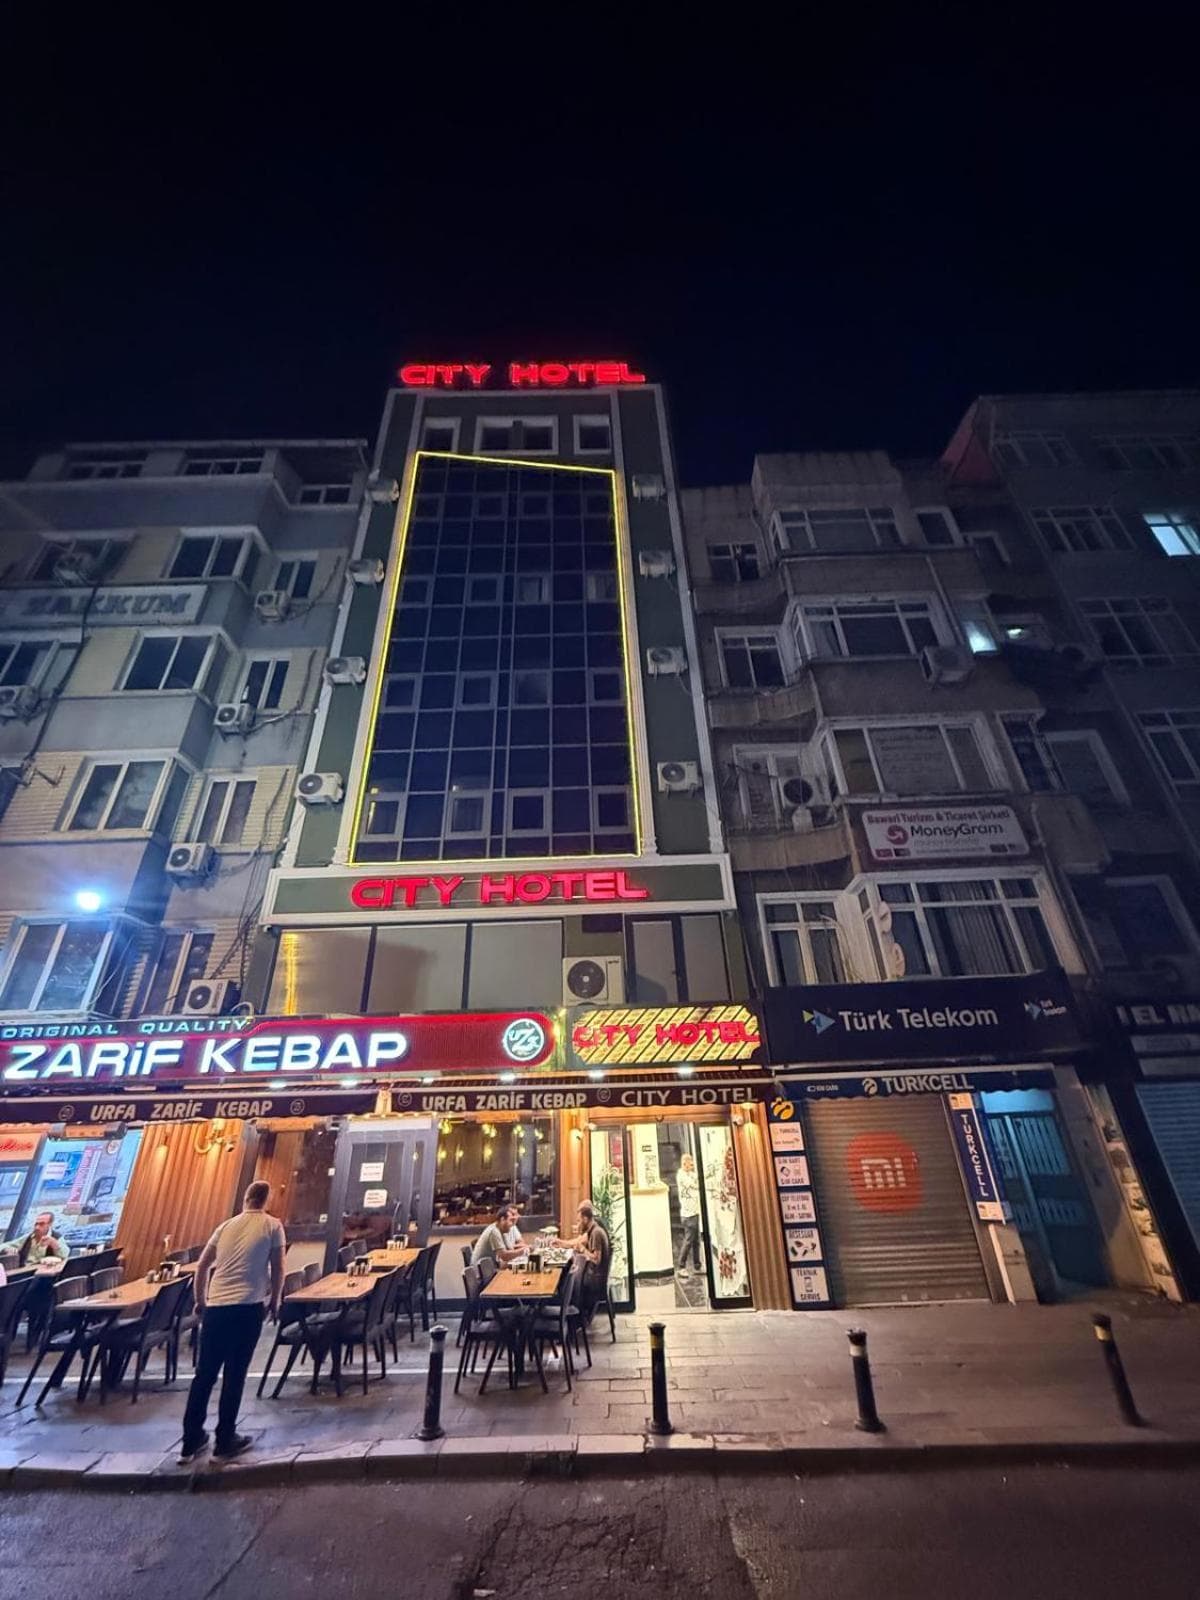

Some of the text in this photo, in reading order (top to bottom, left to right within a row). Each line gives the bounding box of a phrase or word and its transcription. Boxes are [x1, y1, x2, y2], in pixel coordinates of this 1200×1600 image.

[400, 362, 646, 385] CITY HOTEL
[911, 822, 1004, 839] MoneyGram
[351, 871, 648, 908] CITY HOTEL
[2, 1018, 247, 1039] ORIGINAL QUALITY
[839, 1007, 999, 1032] Türk Telekom
[656, 1021, 762, 1046] HOTEL
[199, 1032, 408, 1074] KEBAP
[882, 1074, 975, 1094] TURKCELL
[422, 1095, 466, 1111] URFA
[476, 1091, 525, 1109] ZARİF
[531, 1092, 588, 1108] KEBAP
[621, 1090, 671, 1107] CITY
[681, 1087, 758, 1104] HOTEL
[90, 1103, 136, 1121] URFA
[150, 1099, 203, 1118] ZARİF
[215, 1100, 273, 1117] KEBAP
[961, 1113, 989, 1198] TURKCELL
